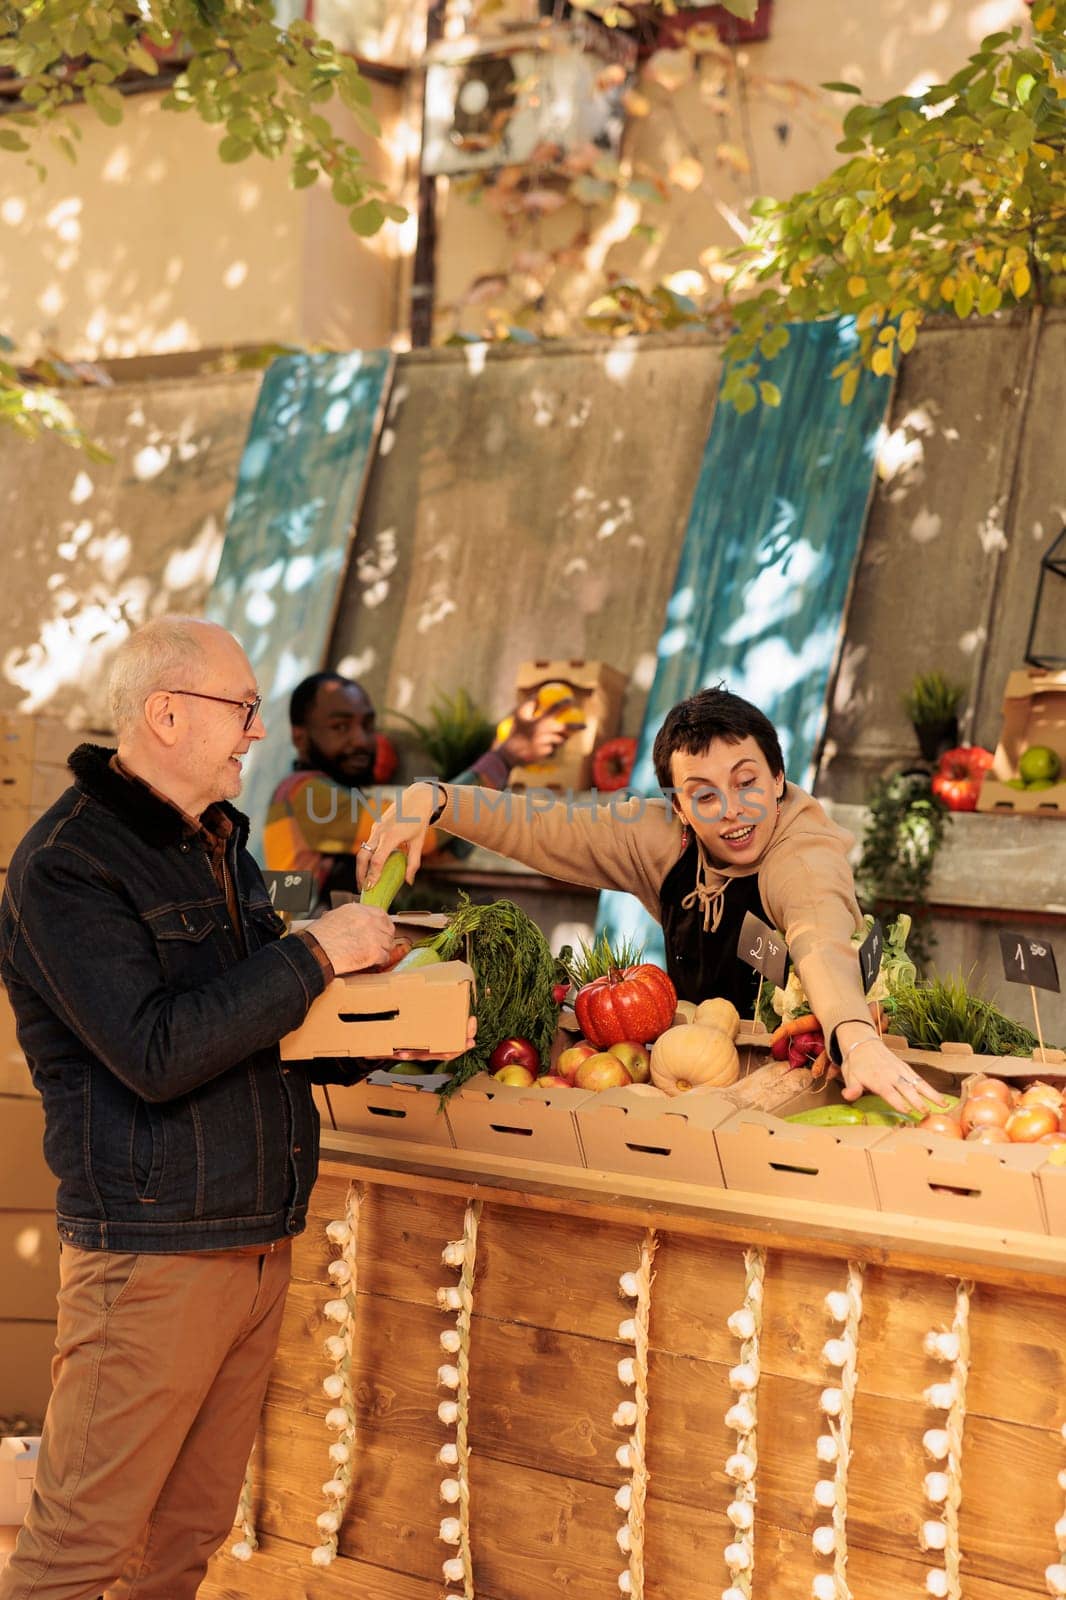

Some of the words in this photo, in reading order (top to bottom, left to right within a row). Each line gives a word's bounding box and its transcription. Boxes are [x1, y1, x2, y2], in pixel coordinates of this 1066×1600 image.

[268, 880, 278, 905] 1
[750, 936, 764, 960] 2
[1014, 943, 1025, 971] 1
